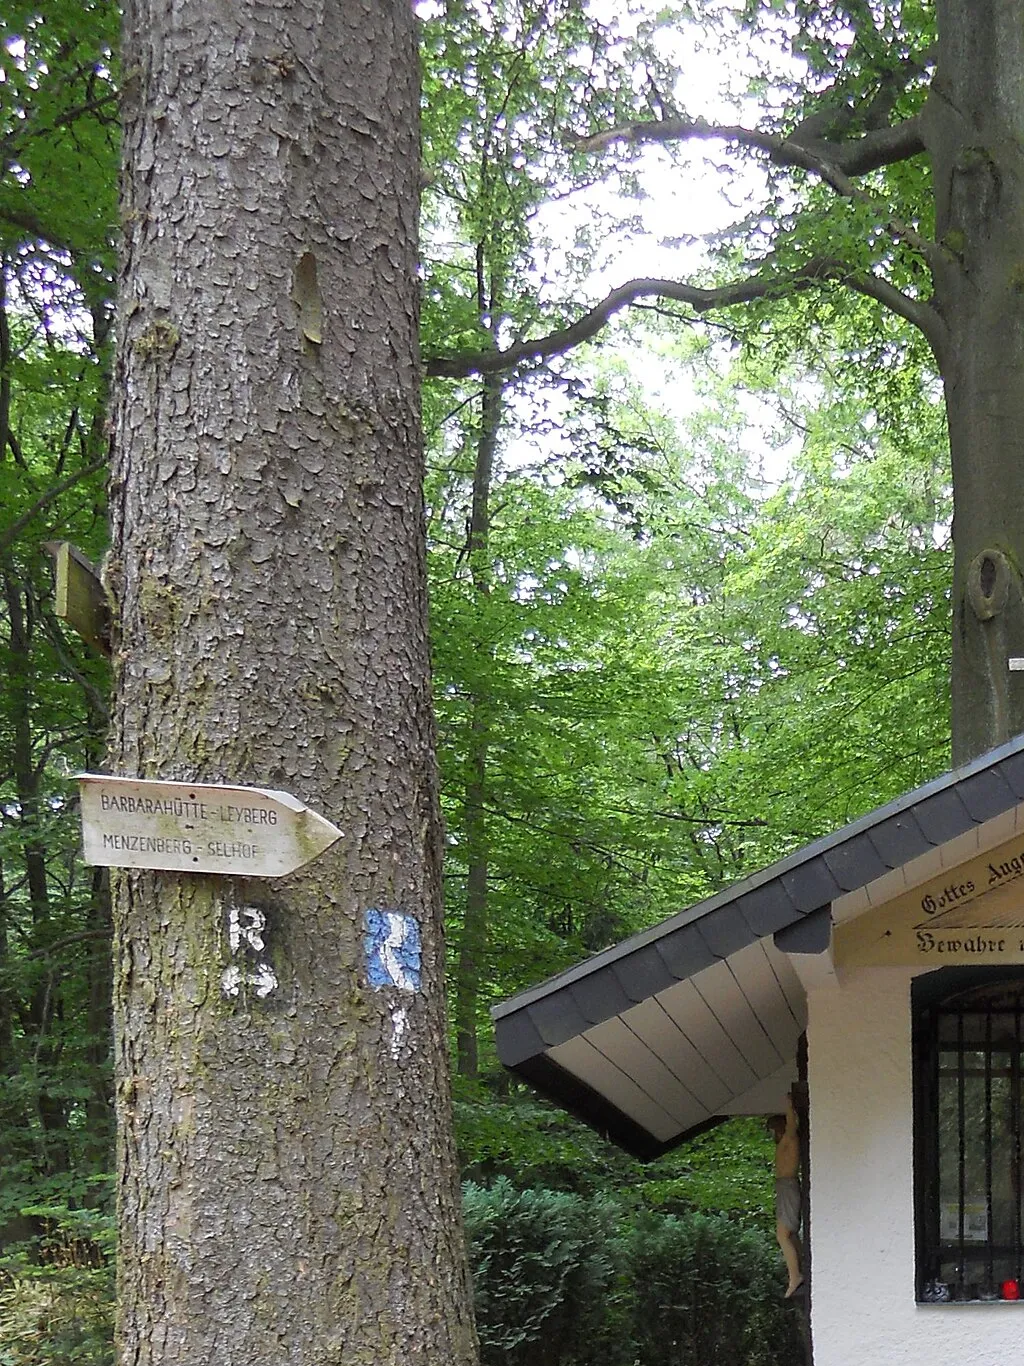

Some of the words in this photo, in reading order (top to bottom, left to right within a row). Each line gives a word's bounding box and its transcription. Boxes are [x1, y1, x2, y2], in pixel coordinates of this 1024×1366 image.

[101, 794, 208, 819] BARBARAHÜTTE
[220, 806, 278, 825] LEYBERG
[103, 834, 192, 854] MENZENBERG
[207, 841, 260, 859] SELHOF
[921, 881, 975, 914] Gottes
[916, 930, 1005, 953] Bewahre
